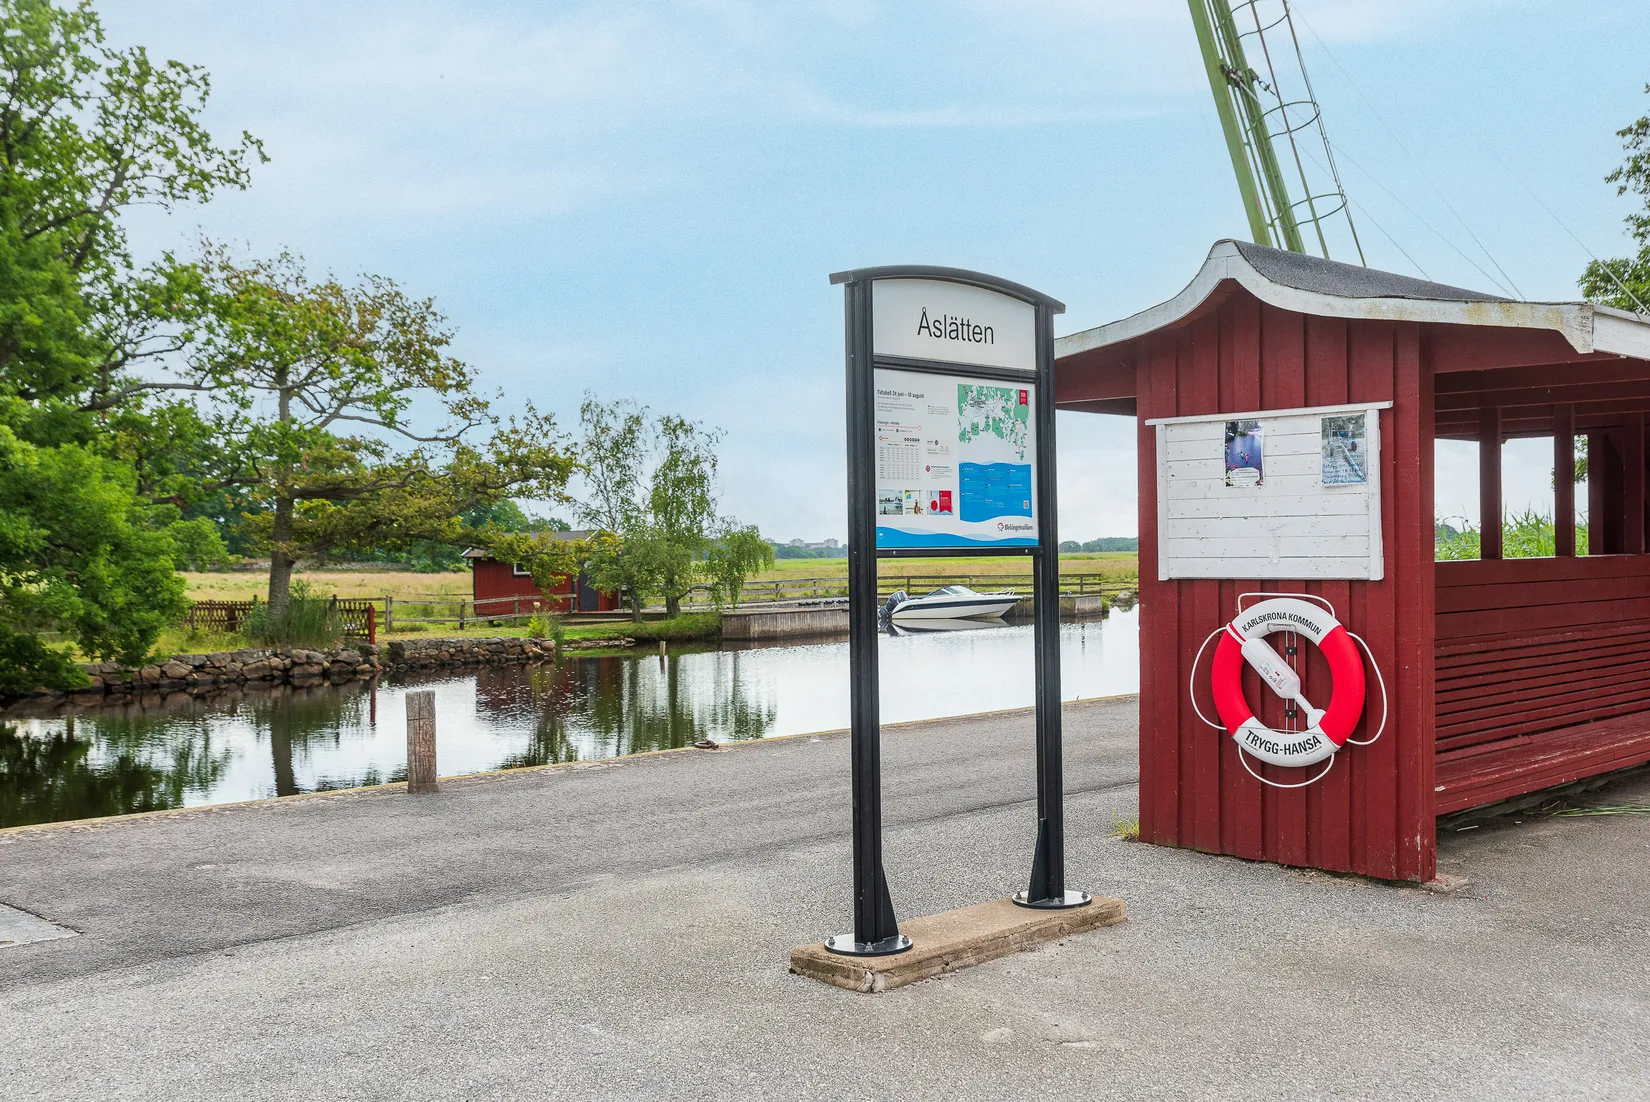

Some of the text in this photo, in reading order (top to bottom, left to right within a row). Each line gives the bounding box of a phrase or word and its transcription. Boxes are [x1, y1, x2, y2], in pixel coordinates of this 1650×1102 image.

[917, 306, 995, 345] Åslätten
[1004, 523, 1034, 532] Blekingetrafiken
[1242, 612, 1322, 635] KARLSKRONA KOMMUN
[1245, 730, 1322, 756] TRYGG-HANSA
